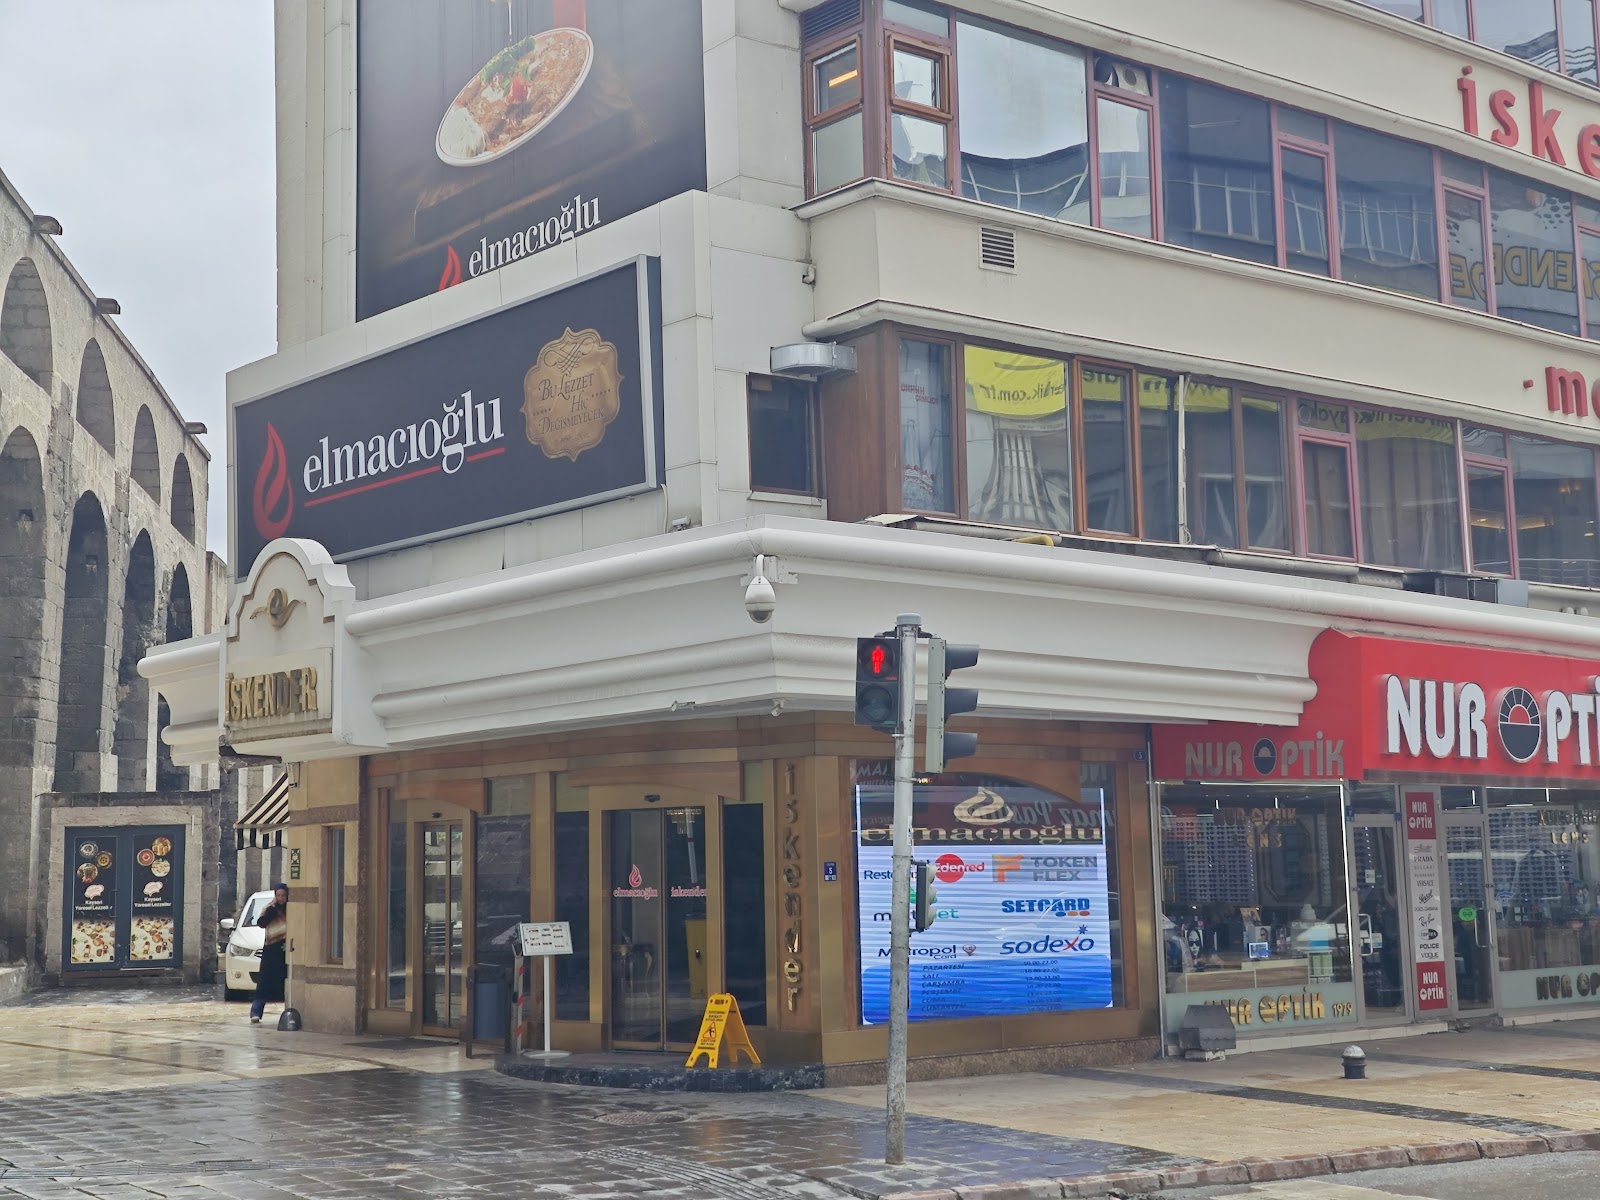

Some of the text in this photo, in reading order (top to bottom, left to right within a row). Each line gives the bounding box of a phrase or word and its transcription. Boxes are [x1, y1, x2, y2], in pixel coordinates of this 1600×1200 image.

[468, 194, 600, 277] elmacıoğlu
[303, 390, 505, 474] elmacıoğlu
[225, 667, 318, 722] İSKENDER
[1383, 674, 1488, 758] NUR
[1185, 730, 1345, 777] NUR OPTİK
[1412, 801, 1428, 813] NUR
[1408, 814, 1433, 829] OPTİK
[936, 862, 985, 873] Edenred
[1030, 856, 1098, 869] TOKEN
[1032, 870, 1081, 882] FLEX
[1001, 898, 1090, 913] SETCARD
[999, 934, 1095, 955] sodexo
[1422, 971, 1439, 985] NUR
[1536, 974, 1573, 1000] NUR
[1419, 985, 1444, 1001] OPTİK
[1258, 986, 1326, 1023] OPTİK
[1331, 1002, 1353, 1017] 1979
